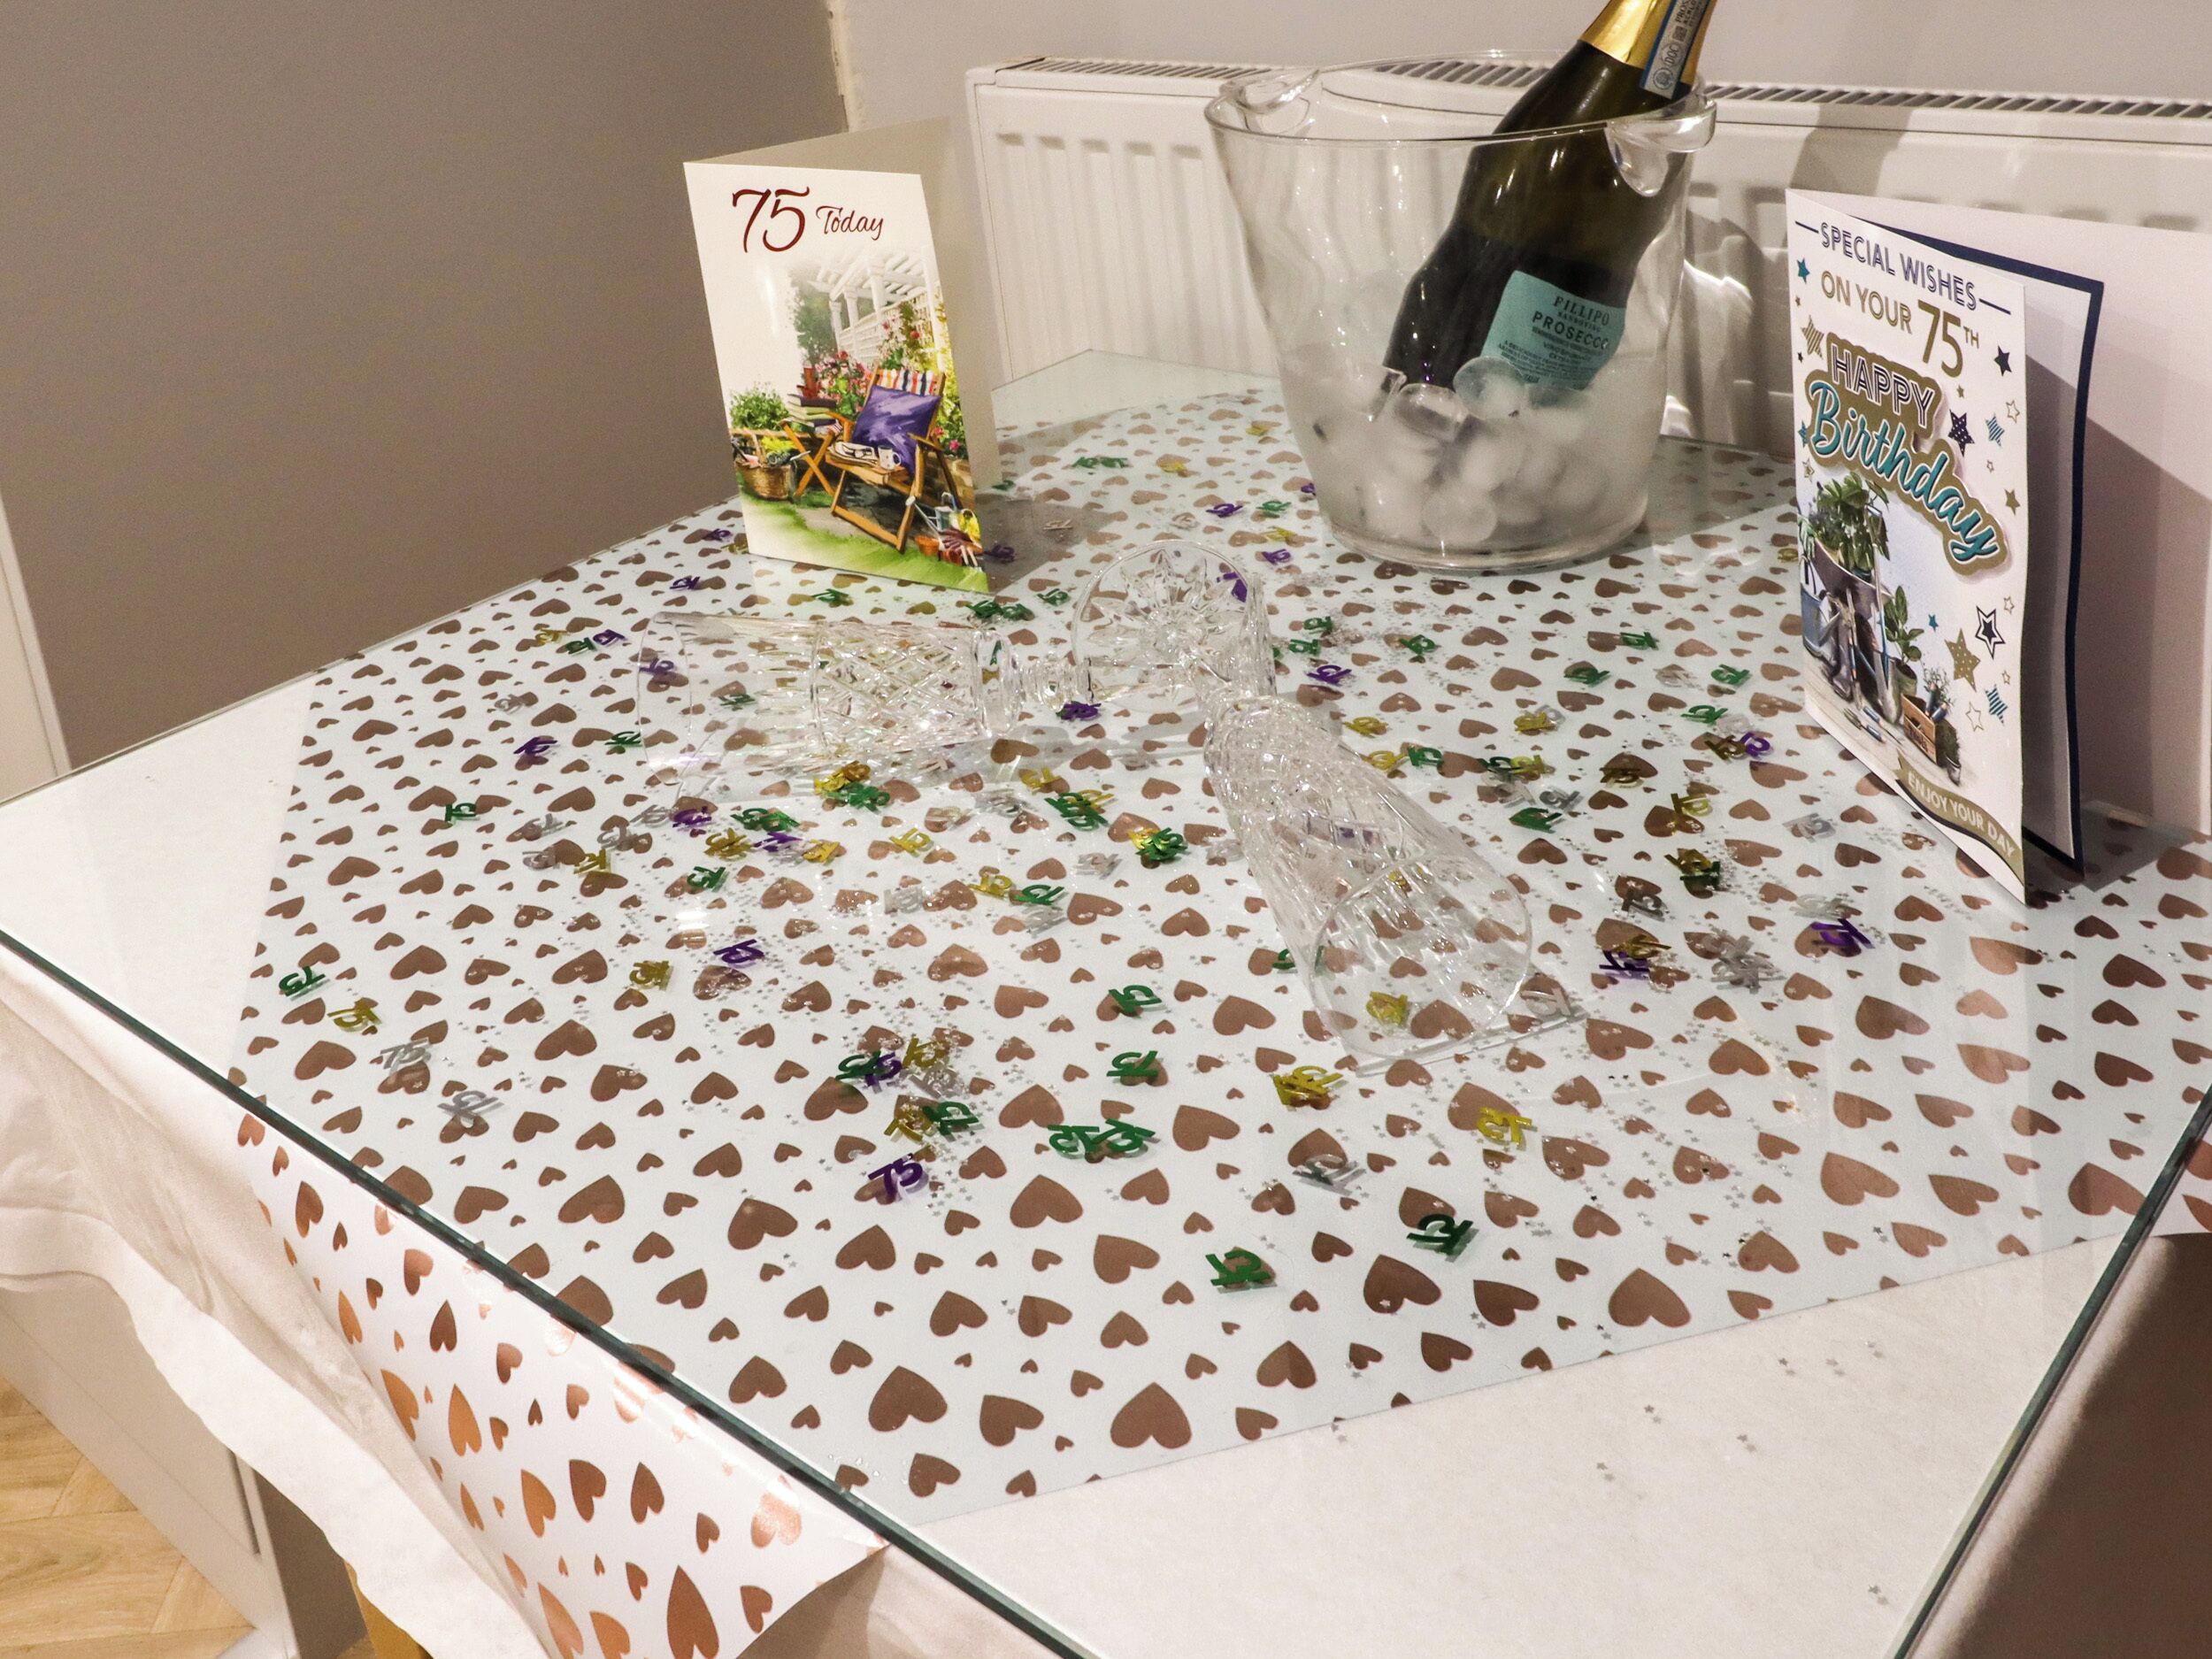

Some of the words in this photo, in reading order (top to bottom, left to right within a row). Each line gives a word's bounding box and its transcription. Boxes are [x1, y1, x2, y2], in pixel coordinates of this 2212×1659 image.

[732, 186, 810, 253] 75
[815, 204, 885, 241] Today
[1819, 221, 1896, 276] SPECIAL
[1900, 252, 1978, 311] WISHES
[1820, 270, 1851, 306] ON
[1855, 283, 1913, 334] YOUR
[1553, 296, 1610, 326] FILLIPO
[1831, 343, 1936, 428] HAPPY
[1809, 380, 2001, 562] Birthday
[1907, 771, 1948, 813] ENJOY
[1949, 798, 1984, 830] YOUR
[1986, 821, 2016, 858] DAY
[868, 1152, 924, 1198] 75
